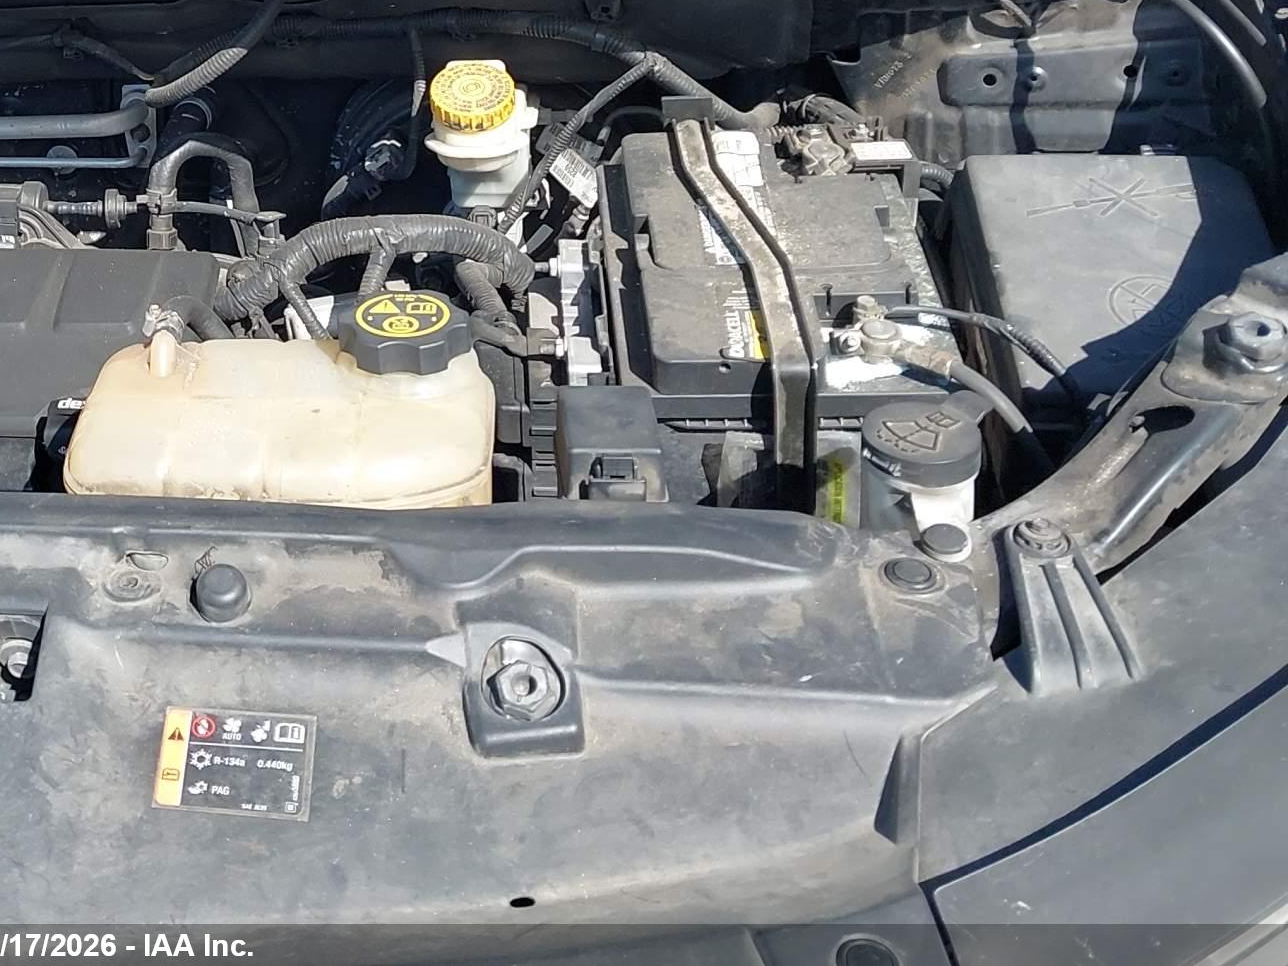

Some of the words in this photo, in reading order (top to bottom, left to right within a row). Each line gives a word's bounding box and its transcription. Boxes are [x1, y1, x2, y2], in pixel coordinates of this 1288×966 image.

[222, 732, 242, 741] AUTO
[213, 756, 246, 767] R-134a
[256, 759, 294, 772] 0.440kg
[211, 785, 230, 796] PAG
